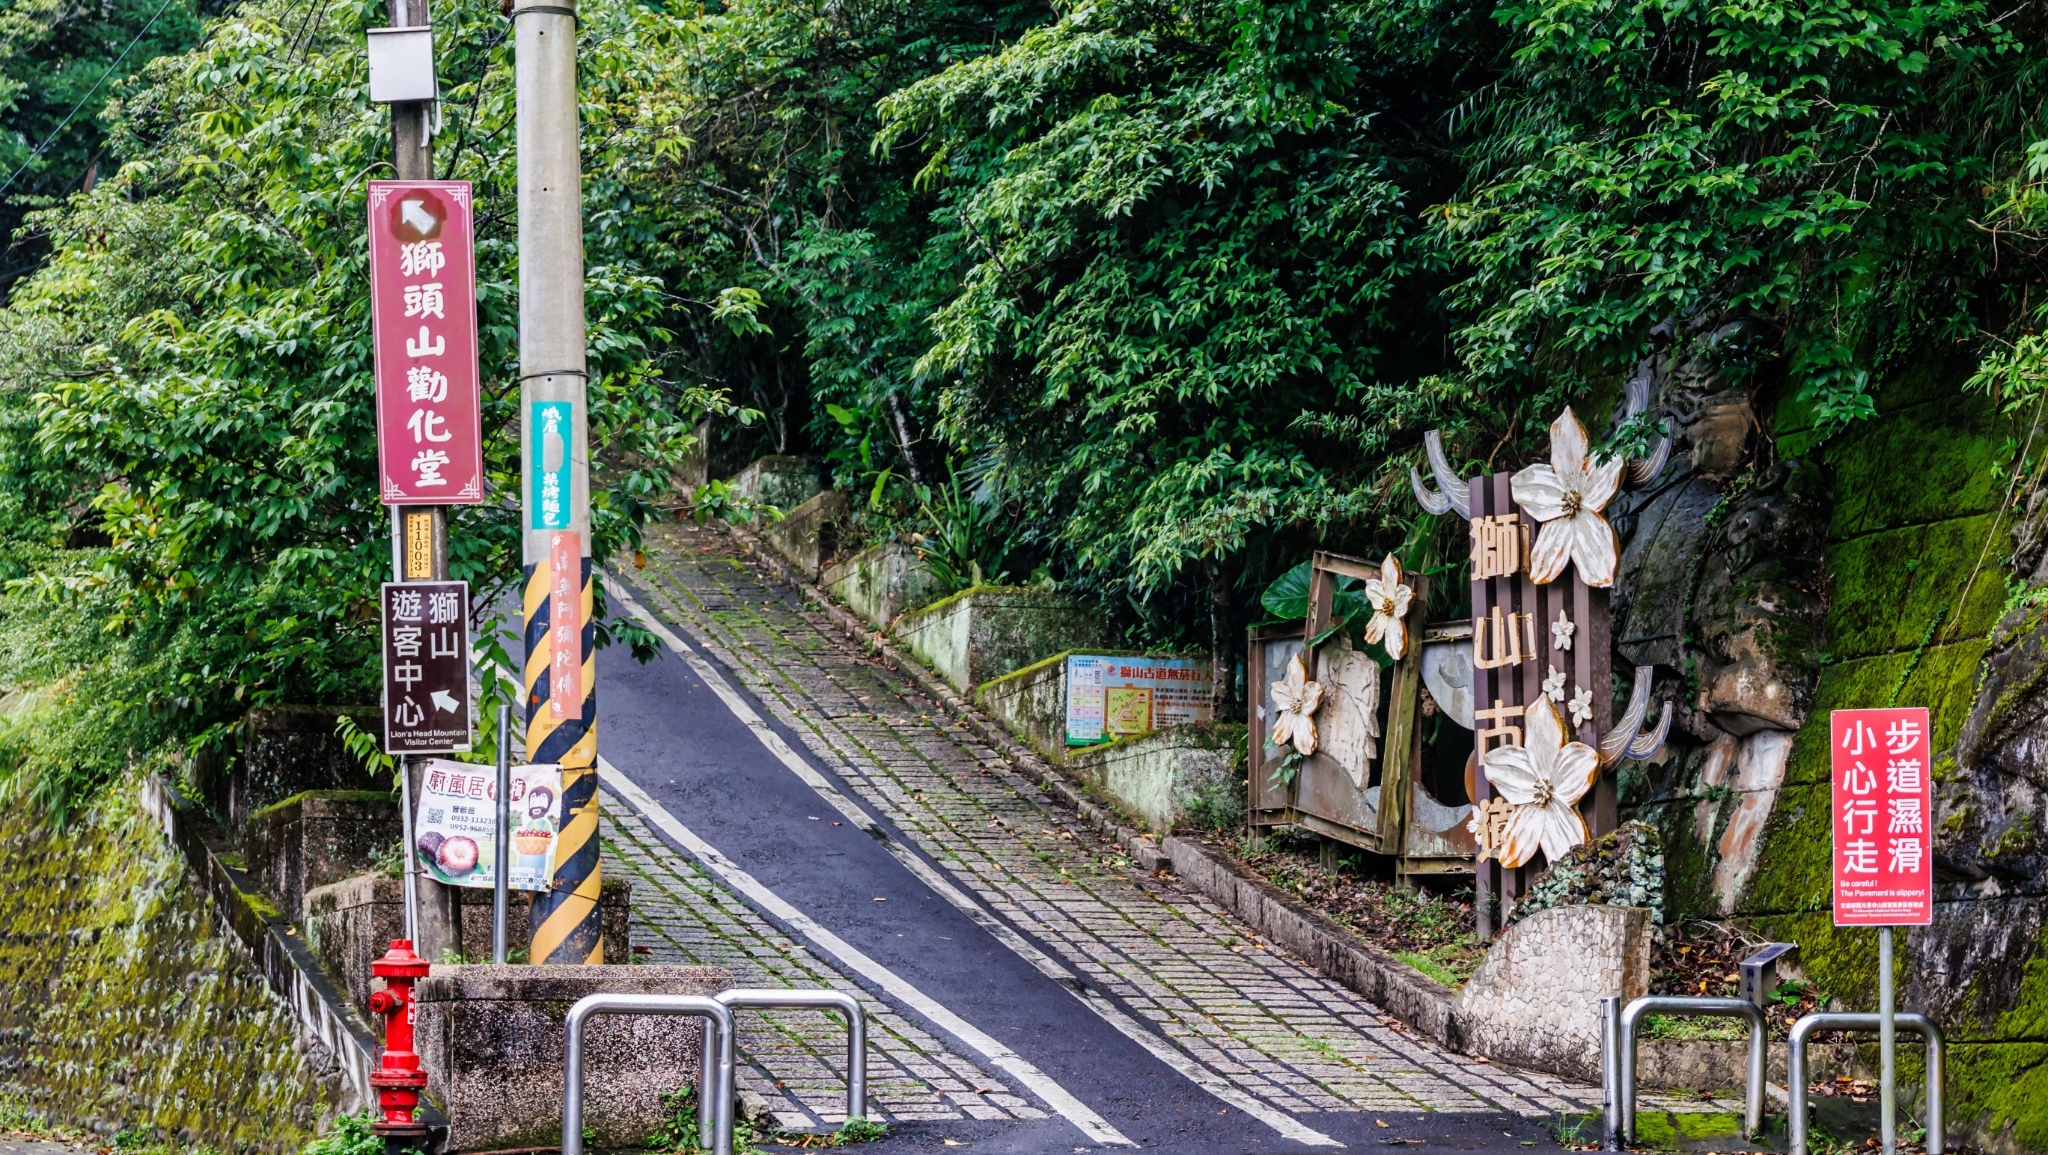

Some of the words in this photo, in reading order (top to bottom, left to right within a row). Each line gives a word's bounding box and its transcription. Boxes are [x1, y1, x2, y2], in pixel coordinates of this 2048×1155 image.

[400, 240, 452, 487] 獅頭山勸化堂
[414, 521, 423, 571] 11003
[391, 590, 425, 727] 遊客中心
[429, 592, 459, 660] 獅山
[555, 550, 575, 697] 南無阿彌陀佛
[429, 770, 486, 796] 蔚嵐居
[434, 729, 467, 737] Mountain
[1841, 719, 1879, 874] 小心行走
[1885, 719, 1923, 874] 步道濕滑
[1840, 889, 1853, 897] The
[1854, 889, 1888, 897] Pavement
[1896, 889, 1925, 897] slippery!
